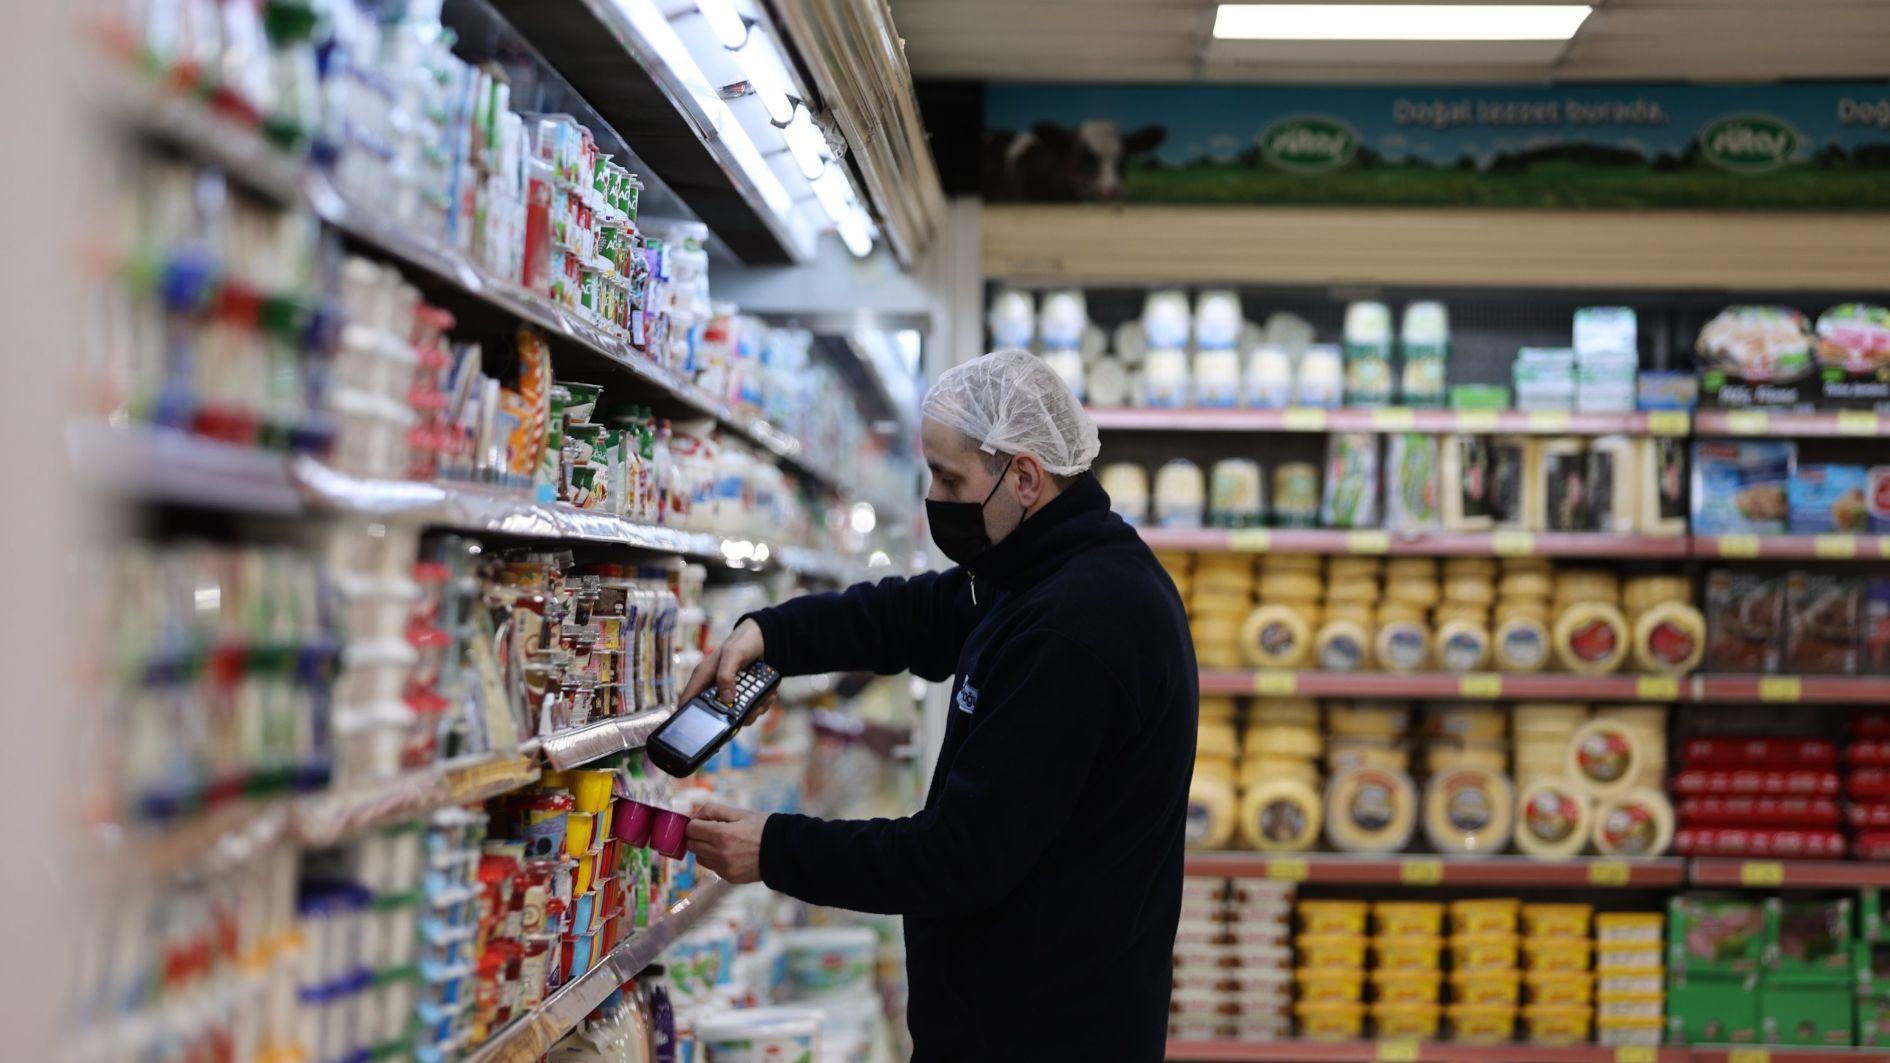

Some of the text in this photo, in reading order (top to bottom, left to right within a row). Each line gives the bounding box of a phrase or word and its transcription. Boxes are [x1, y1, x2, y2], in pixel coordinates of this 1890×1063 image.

[1393, 97, 1670, 129] Doğal lezzet burada.
